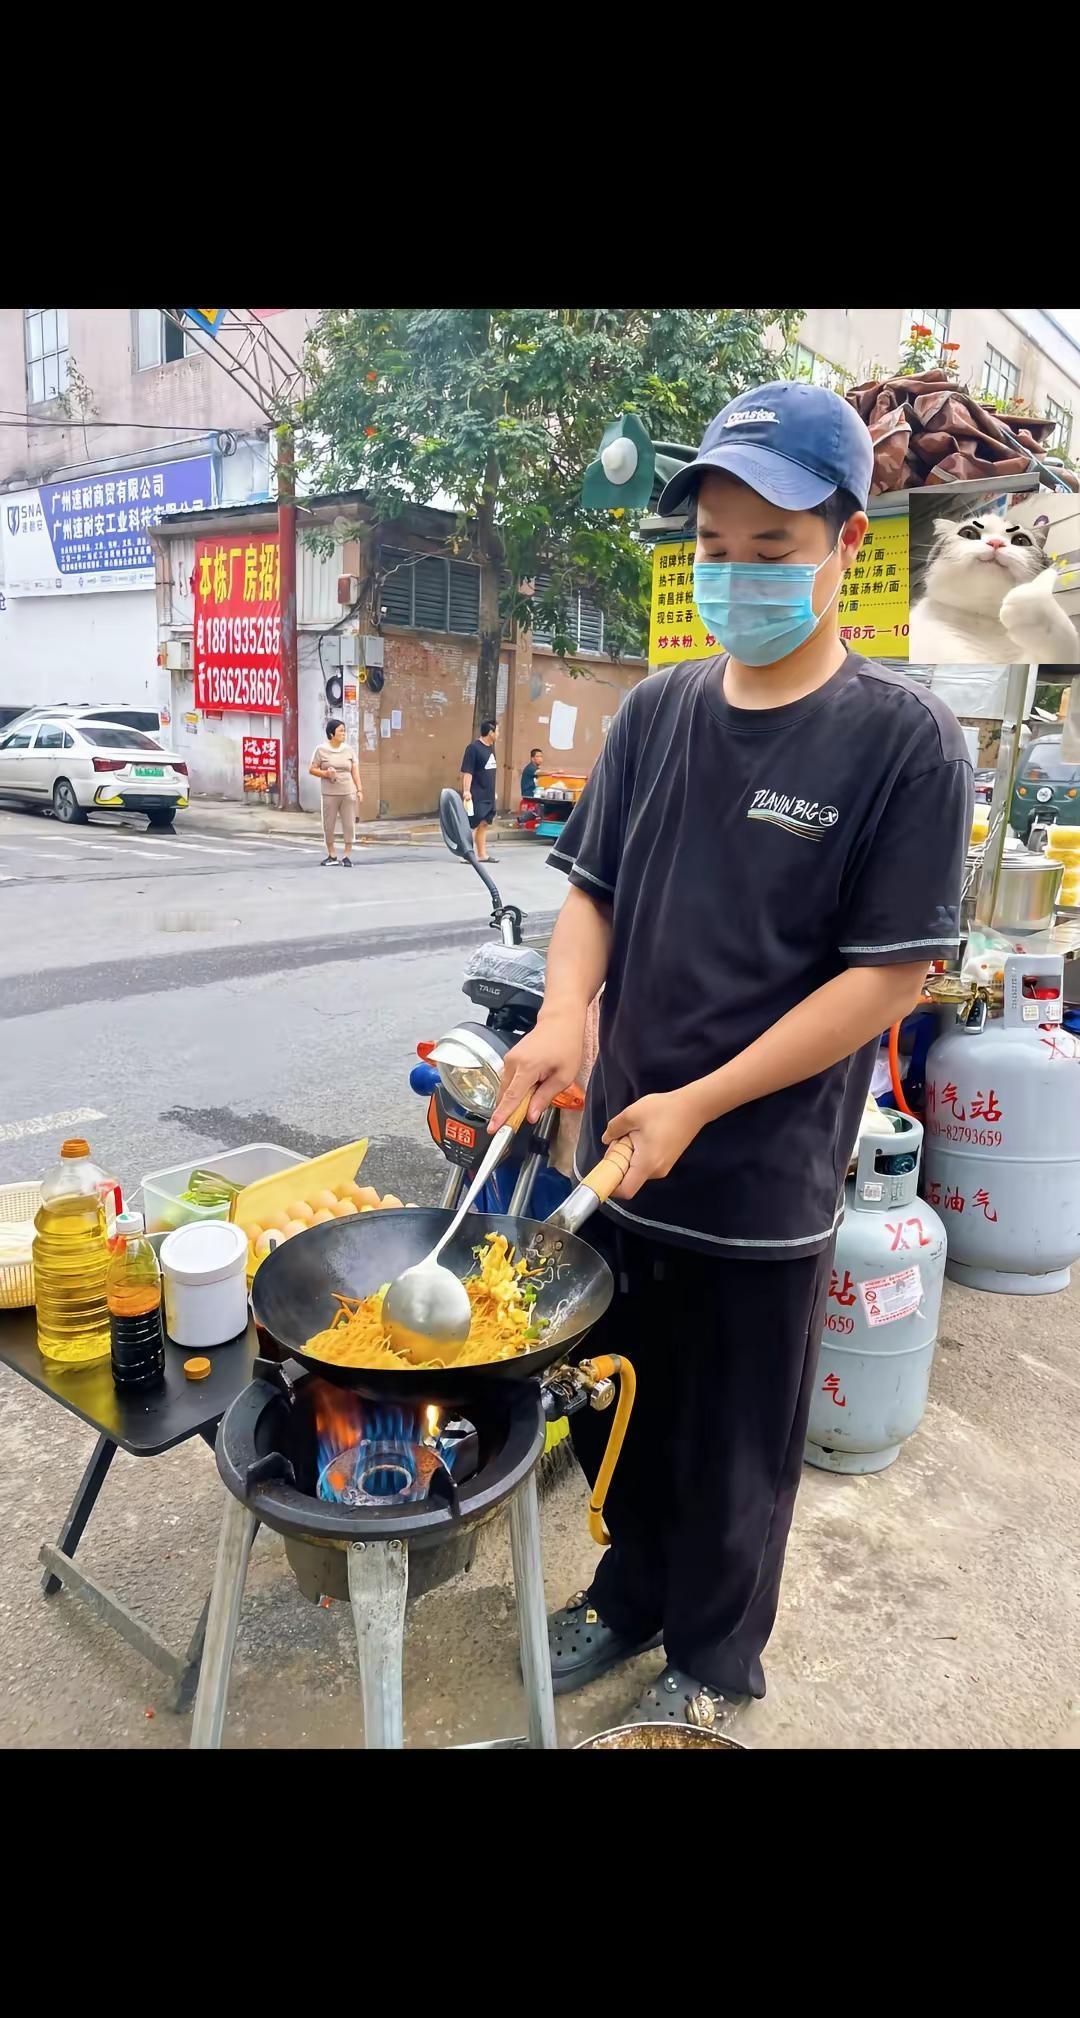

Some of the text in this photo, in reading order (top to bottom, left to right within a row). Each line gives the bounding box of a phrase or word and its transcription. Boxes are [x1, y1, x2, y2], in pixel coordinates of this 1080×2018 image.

[51, 474, 164, 514] 广州速耐商贸有限公司
[21, 504, 42, 518] SNA
[658, 591, 693, 606] 南昌拌粉
[657, 609, 693, 624] 现包云吞
[244, 739, 277, 757] 烧烤
[791, 799, 819, 821] BIG
[821, 1373, 846, 1407] 气
